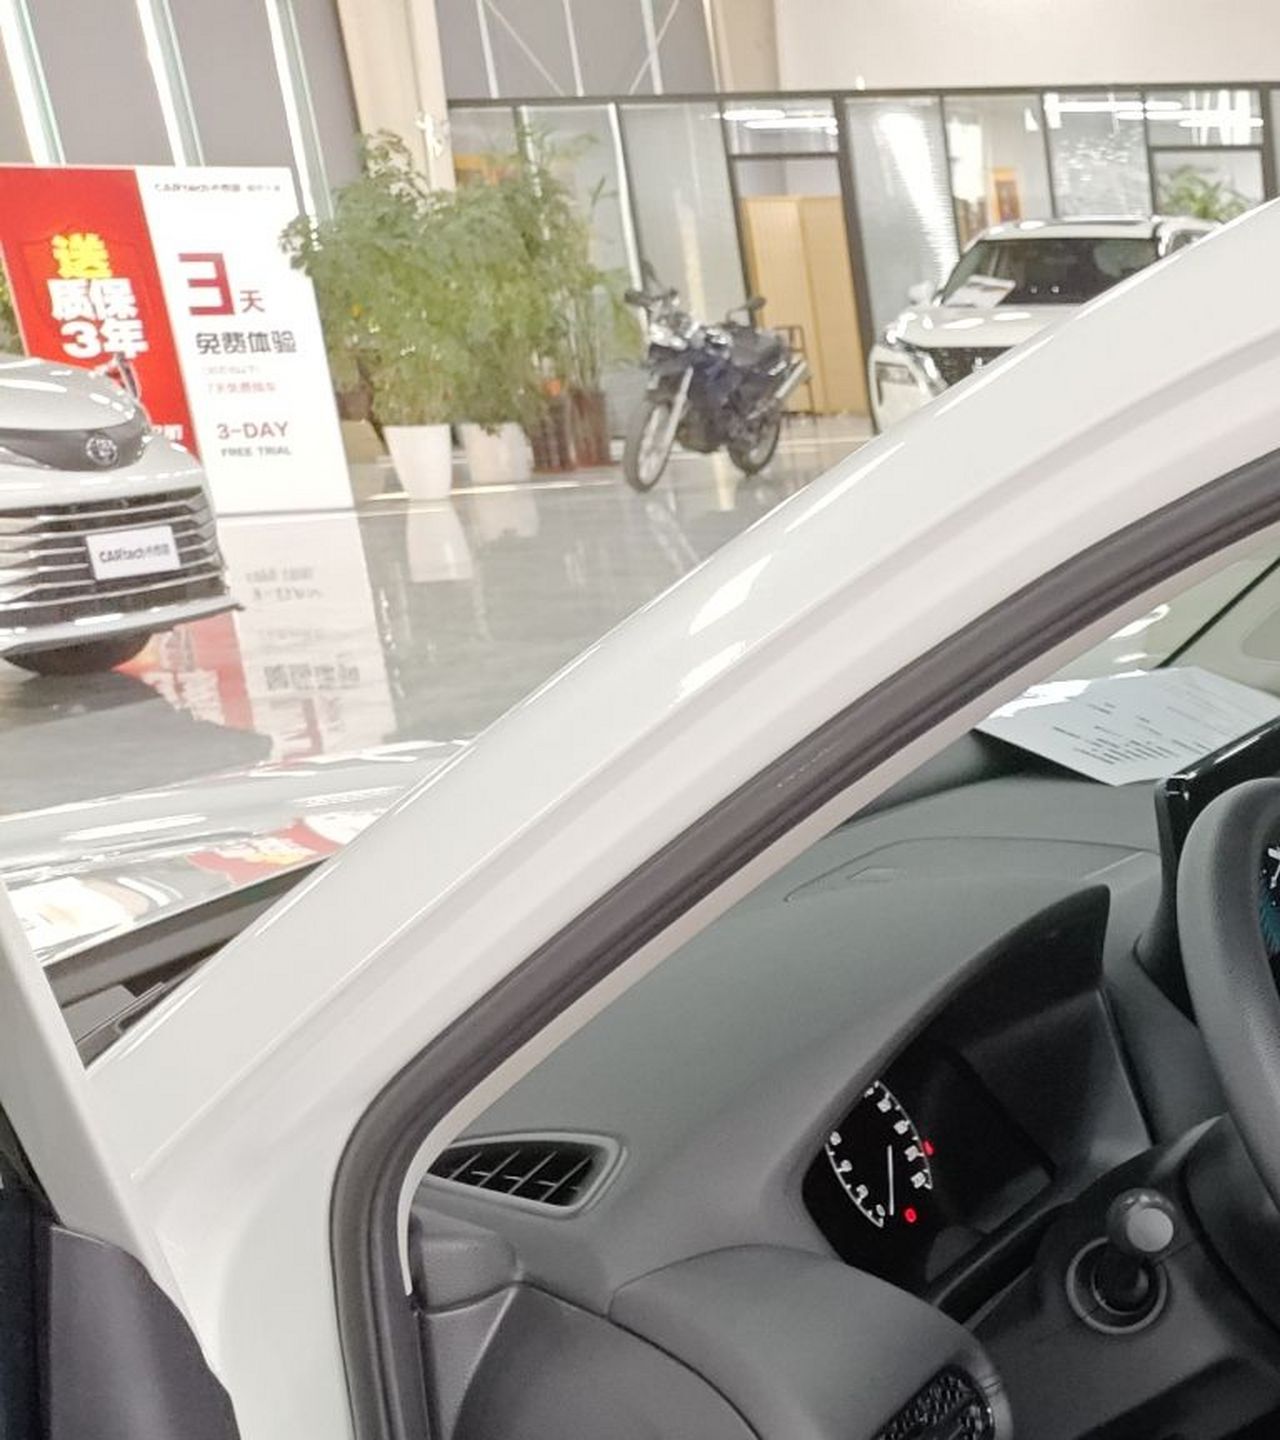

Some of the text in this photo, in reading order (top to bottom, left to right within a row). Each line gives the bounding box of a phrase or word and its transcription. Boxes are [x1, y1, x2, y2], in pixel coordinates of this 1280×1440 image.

[47, 277, 139, 322] 质保
[60, 319, 150, 360] 3年
[195, 330, 297, 355] 免费体验
[216, 421, 288, 440] 3-DAY
[221, 446, 253, 457] FREE
